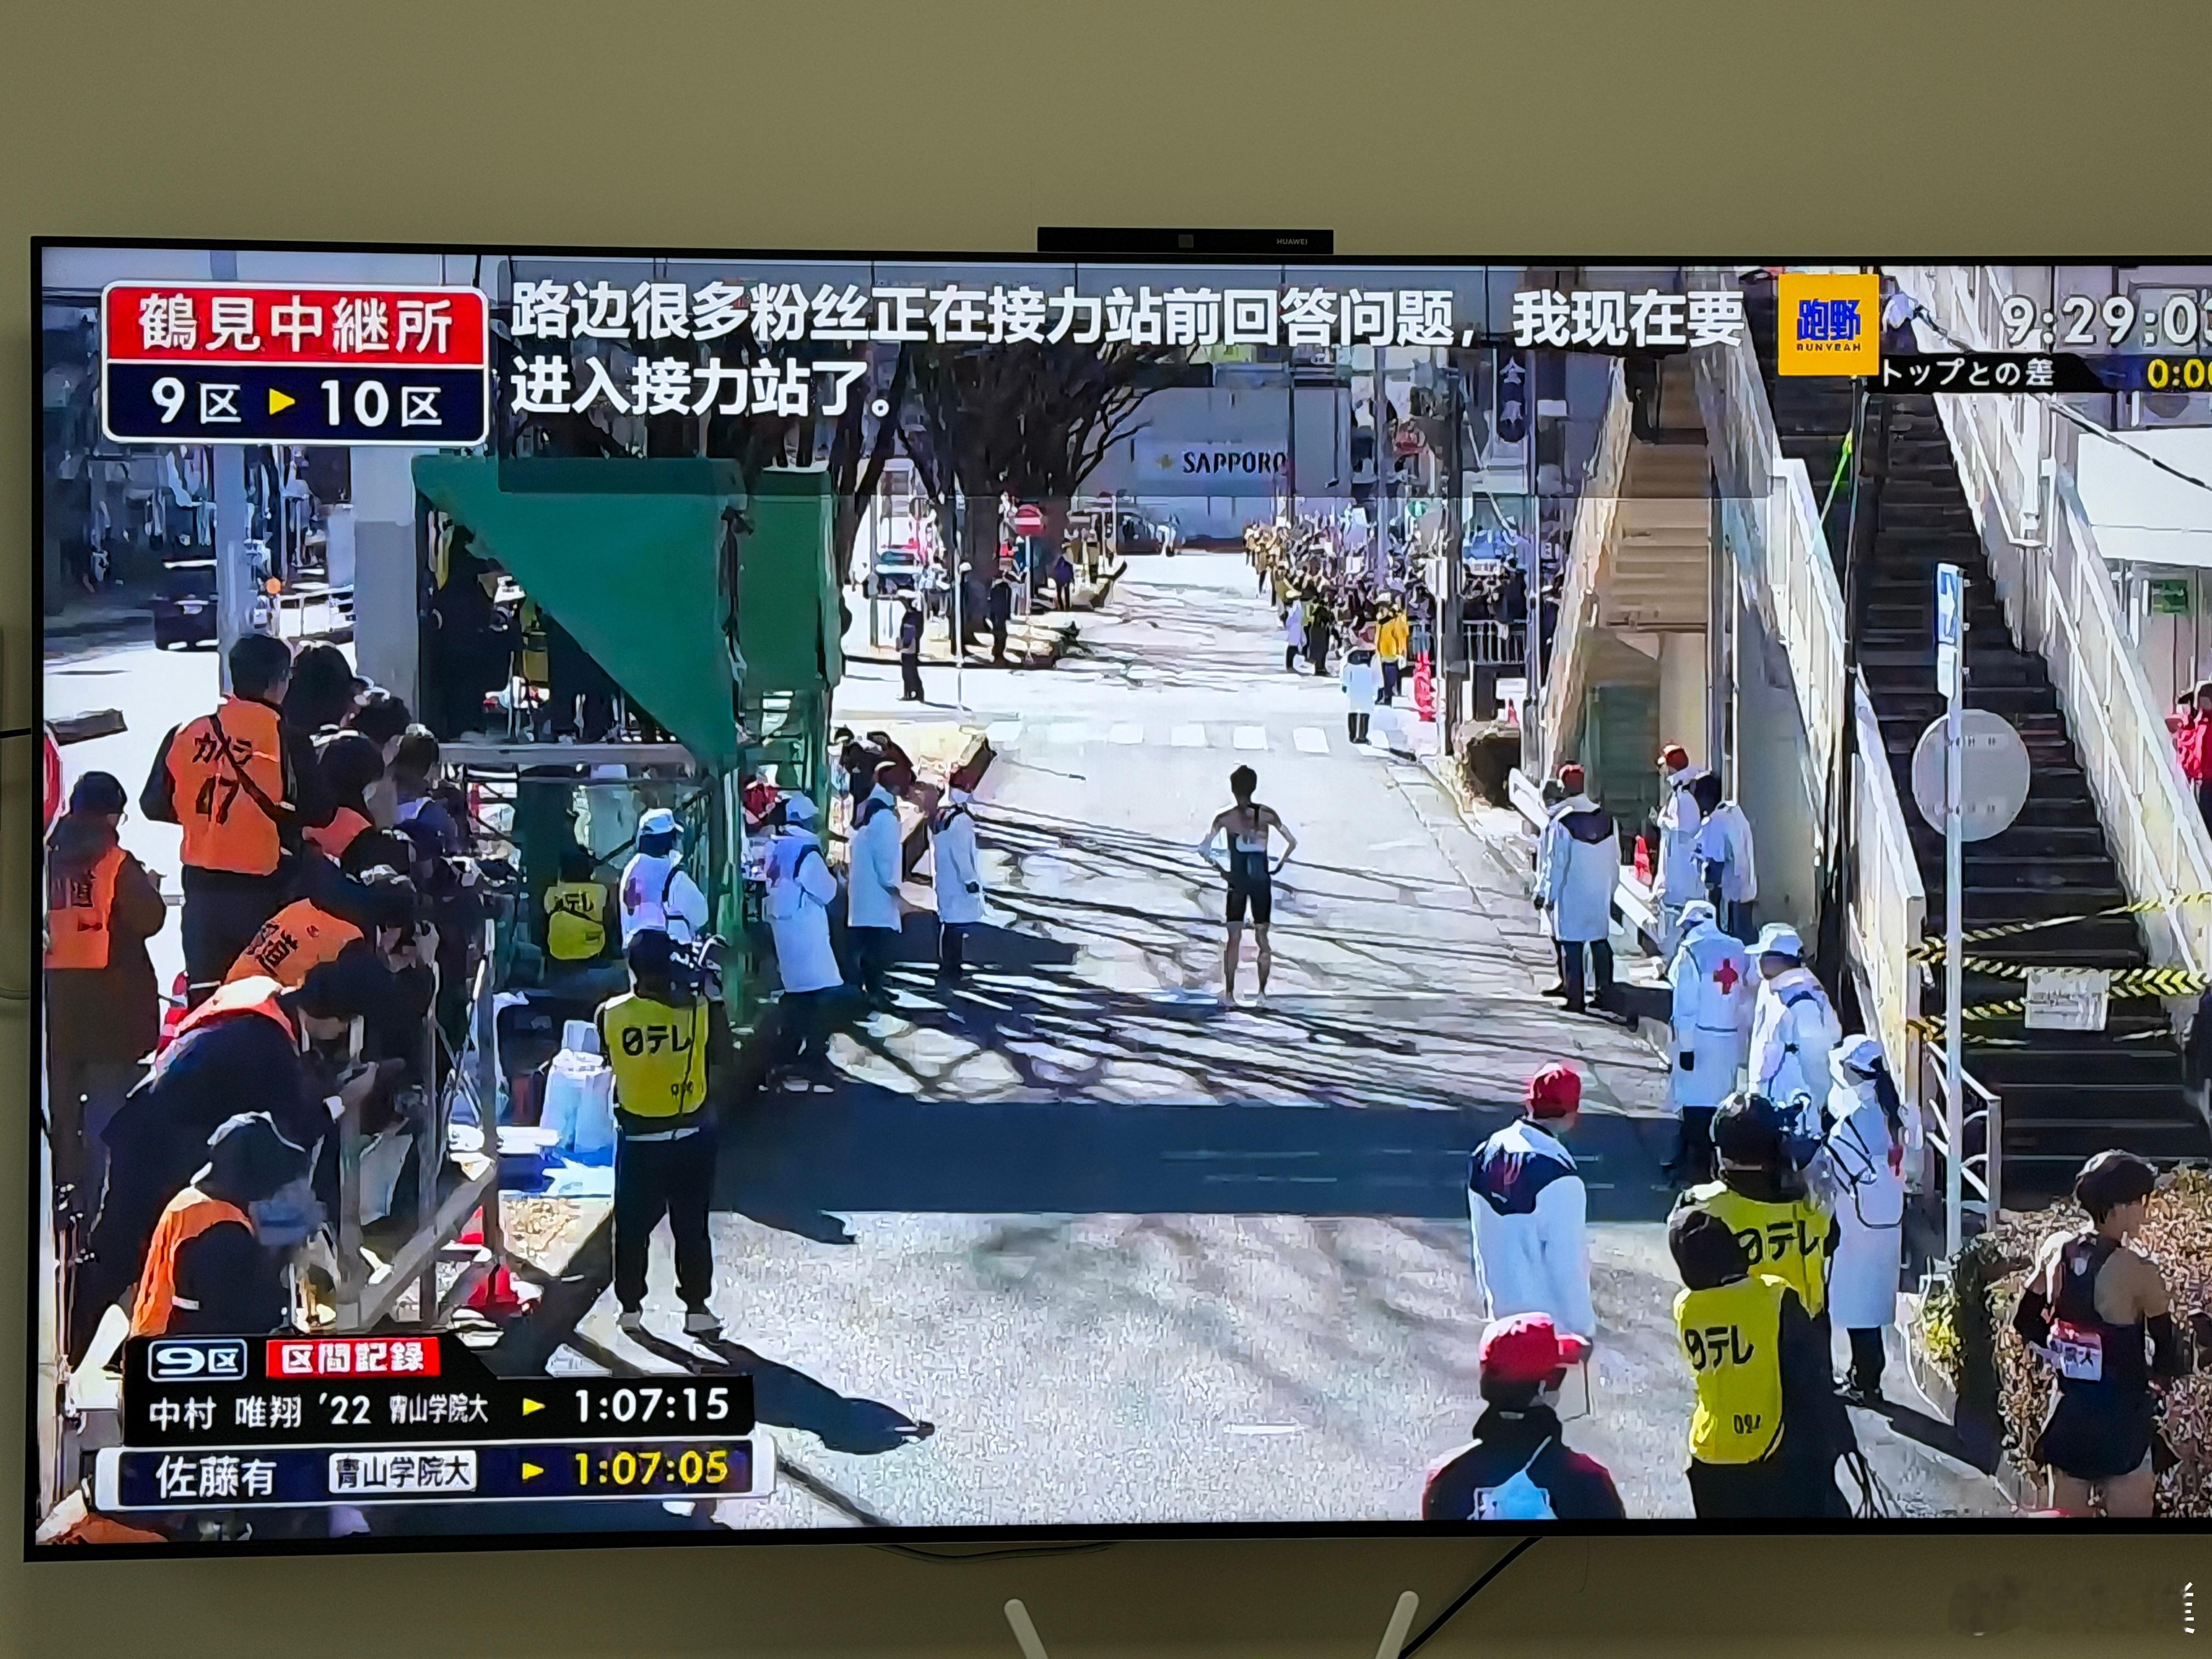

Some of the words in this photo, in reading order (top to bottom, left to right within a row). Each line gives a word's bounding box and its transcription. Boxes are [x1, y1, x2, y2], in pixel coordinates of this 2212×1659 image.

[139, 293, 453, 354] 鶴見中継所
[511, 280, 1745, 349] 路边很多粉丝正在接力站前回答问题，我现在要
[1797, 298, 1861, 341] 跑野
[2001, 295, 2212, 345] 9:29:0
[1796, 343, 1861, 351] RUNYEAH
[510, 356, 889, 417] 进入接力站了。
[1882, 358, 2055, 387] トップとの差
[2147, 359, 2212, 389] 0:0
[151, 377, 241, 424] 9区
[320, 380, 442, 427] 10区
[1182, 451, 1286, 474] SAPPORO
[156, 1347, 239, 1375] 9区
[281, 1342, 424, 1374] 区間記録
[150, 1396, 217, 1431] 中村
[235, 1395, 301, 1428] 唯翔
[390, 1392, 488, 1424] 青山学院大
[575, 1387, 729, 1423] 1:07:15
[155, 1455, 277, 1499] 佐藤有
[336, 1455, 470, 1489] 青山学院大
[575, 1451, 728, 1485] 1:07:05
